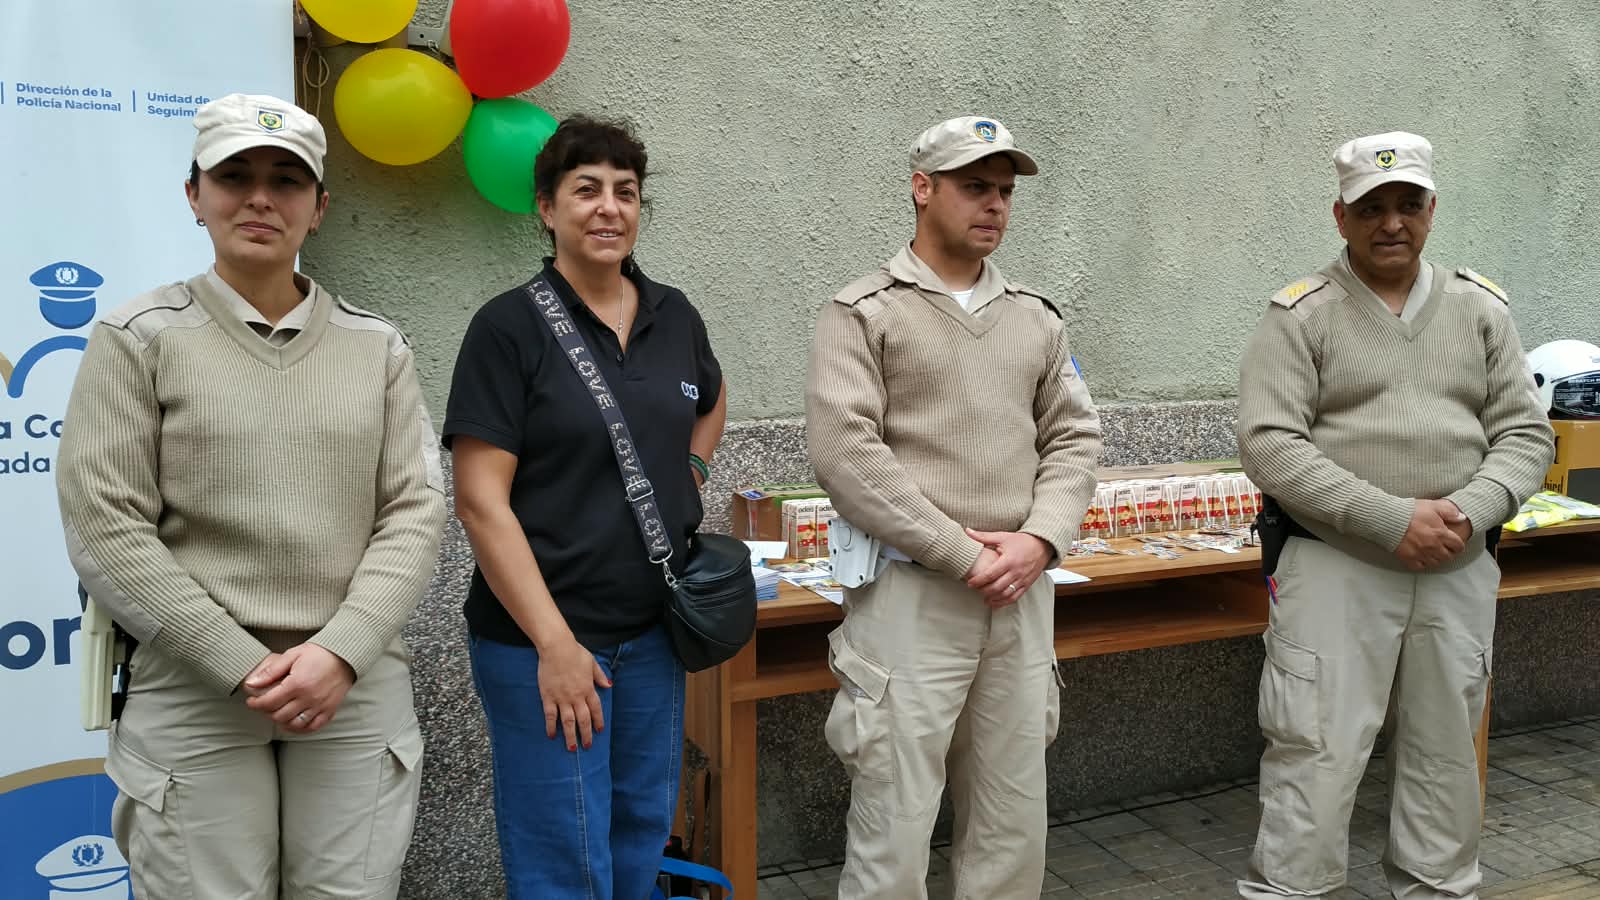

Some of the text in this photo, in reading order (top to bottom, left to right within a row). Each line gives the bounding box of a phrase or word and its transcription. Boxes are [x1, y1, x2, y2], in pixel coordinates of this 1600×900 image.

[16, 82, 112, 98] Dirección de la
[147, 92, 210, 104] Unidad de
[16, 96, 121, 112] Policía Nacional
[568, 345, 615, 410] LOVE
